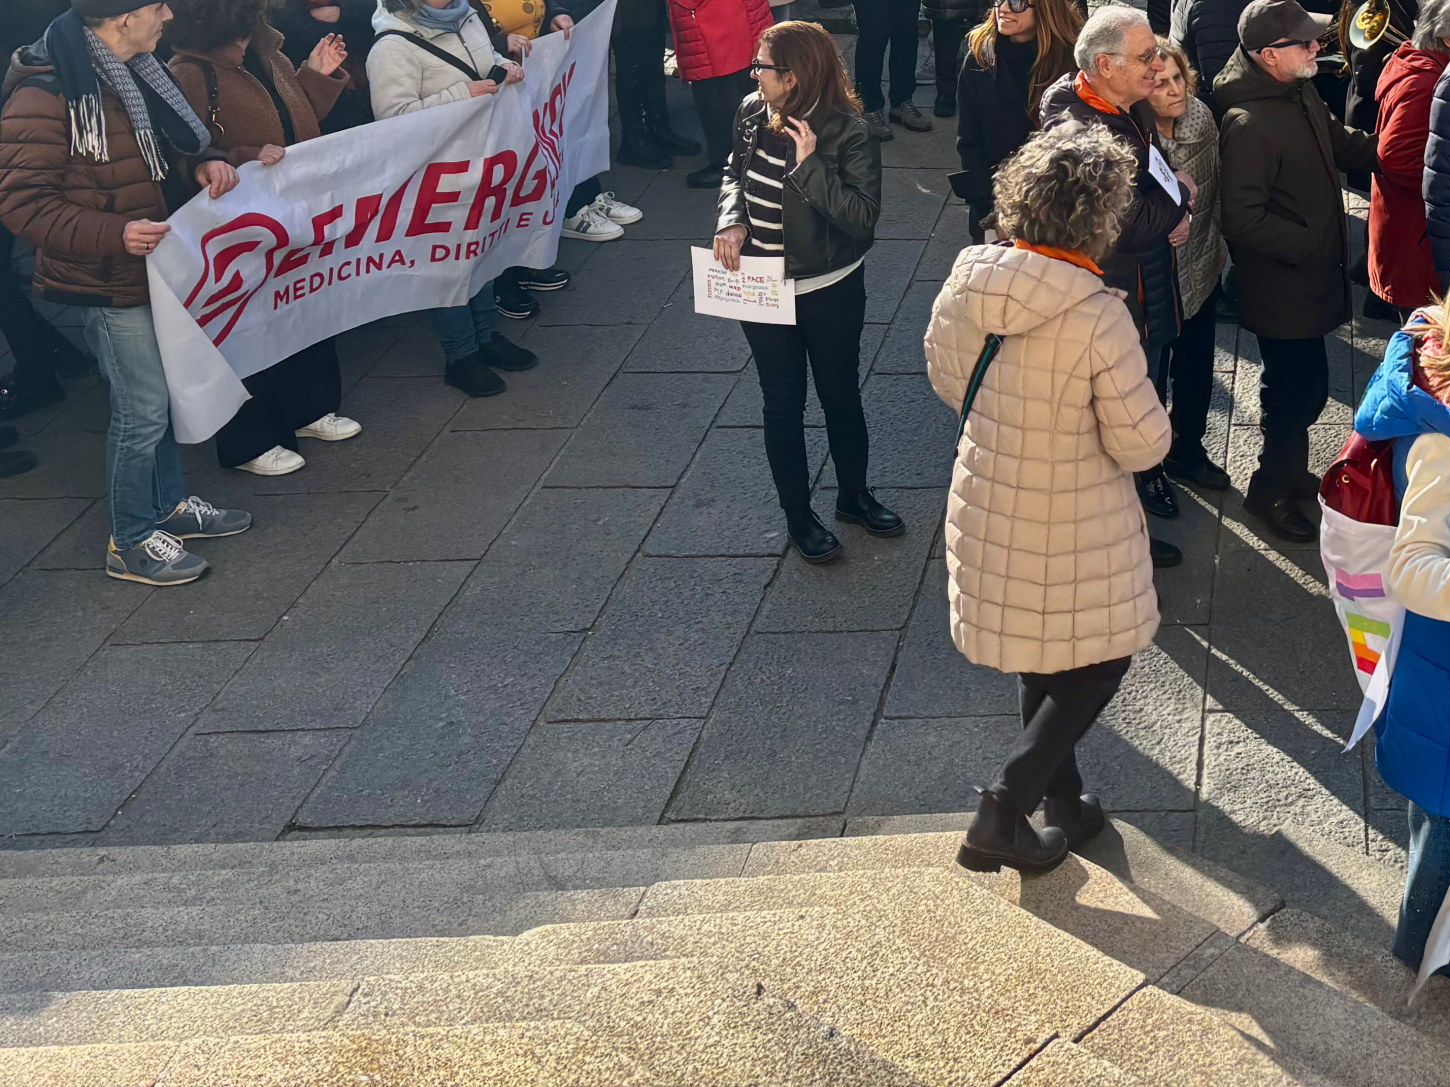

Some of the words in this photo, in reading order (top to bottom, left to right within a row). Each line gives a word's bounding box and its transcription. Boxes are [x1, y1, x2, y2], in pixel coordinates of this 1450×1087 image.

[273, 249, 416, 311] MEDICINA,
[516, 211, 534, 229] E
[747, 275, 765, 284] PACE
